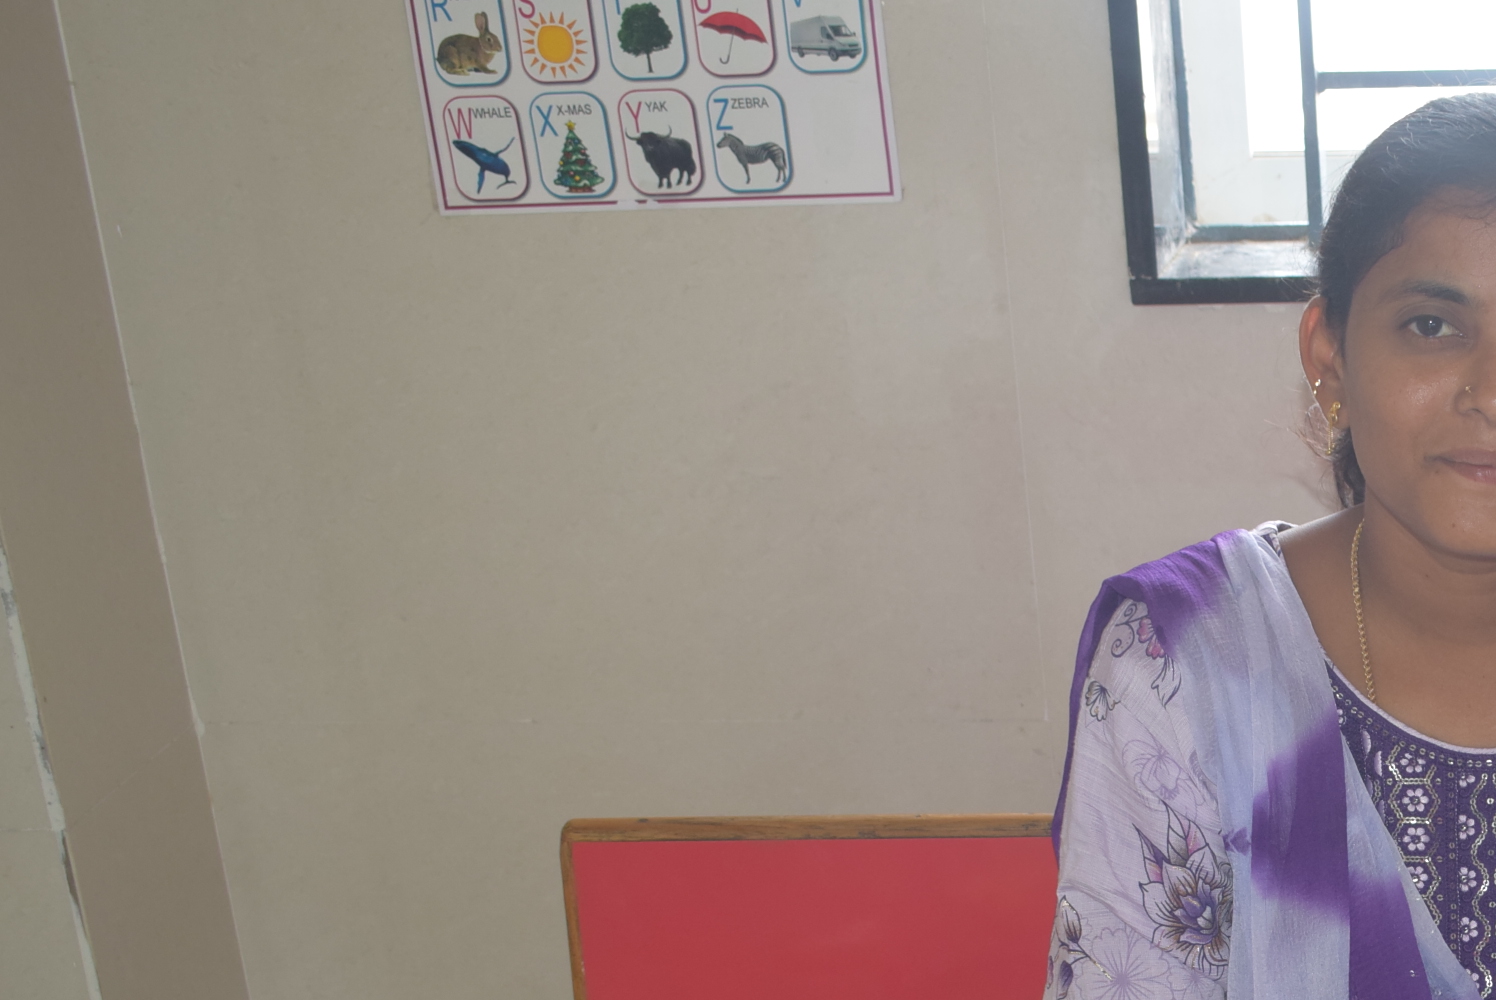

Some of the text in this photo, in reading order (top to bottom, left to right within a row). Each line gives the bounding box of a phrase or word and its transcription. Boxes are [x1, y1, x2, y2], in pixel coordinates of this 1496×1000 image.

[448, 106, 512, 139] W WHALE
[535, 103, 592, 137] X X-MAS
[625, 101, 668, 133] Y YAK
[713, 97, 769, 131] Z ZEBRA
